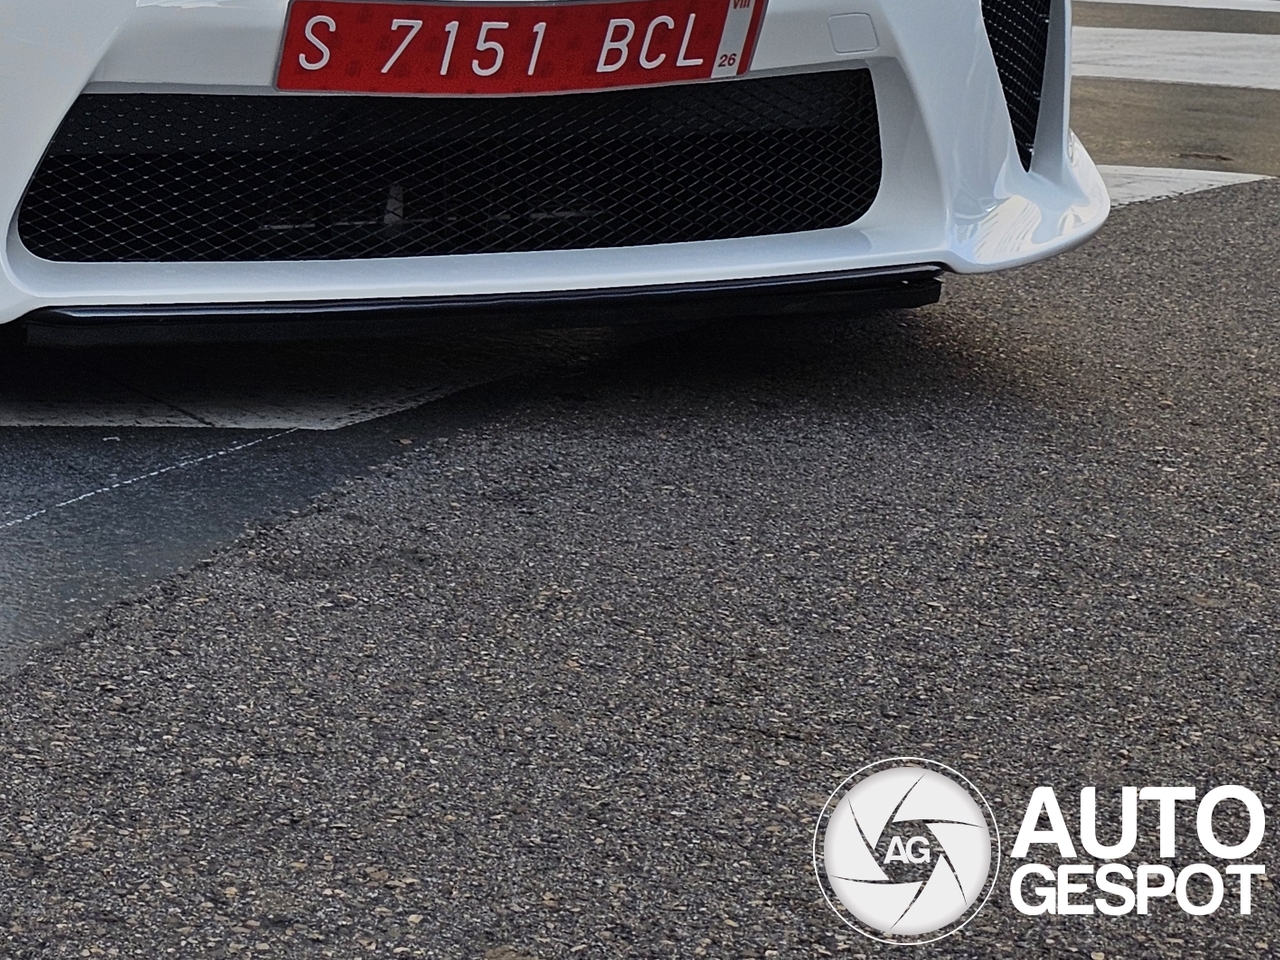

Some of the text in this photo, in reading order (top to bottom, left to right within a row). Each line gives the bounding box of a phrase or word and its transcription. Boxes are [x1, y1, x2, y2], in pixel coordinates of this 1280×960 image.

[298, 13, 705, 76] S 7151 BCL
[718, 53, 737, 68] 26
